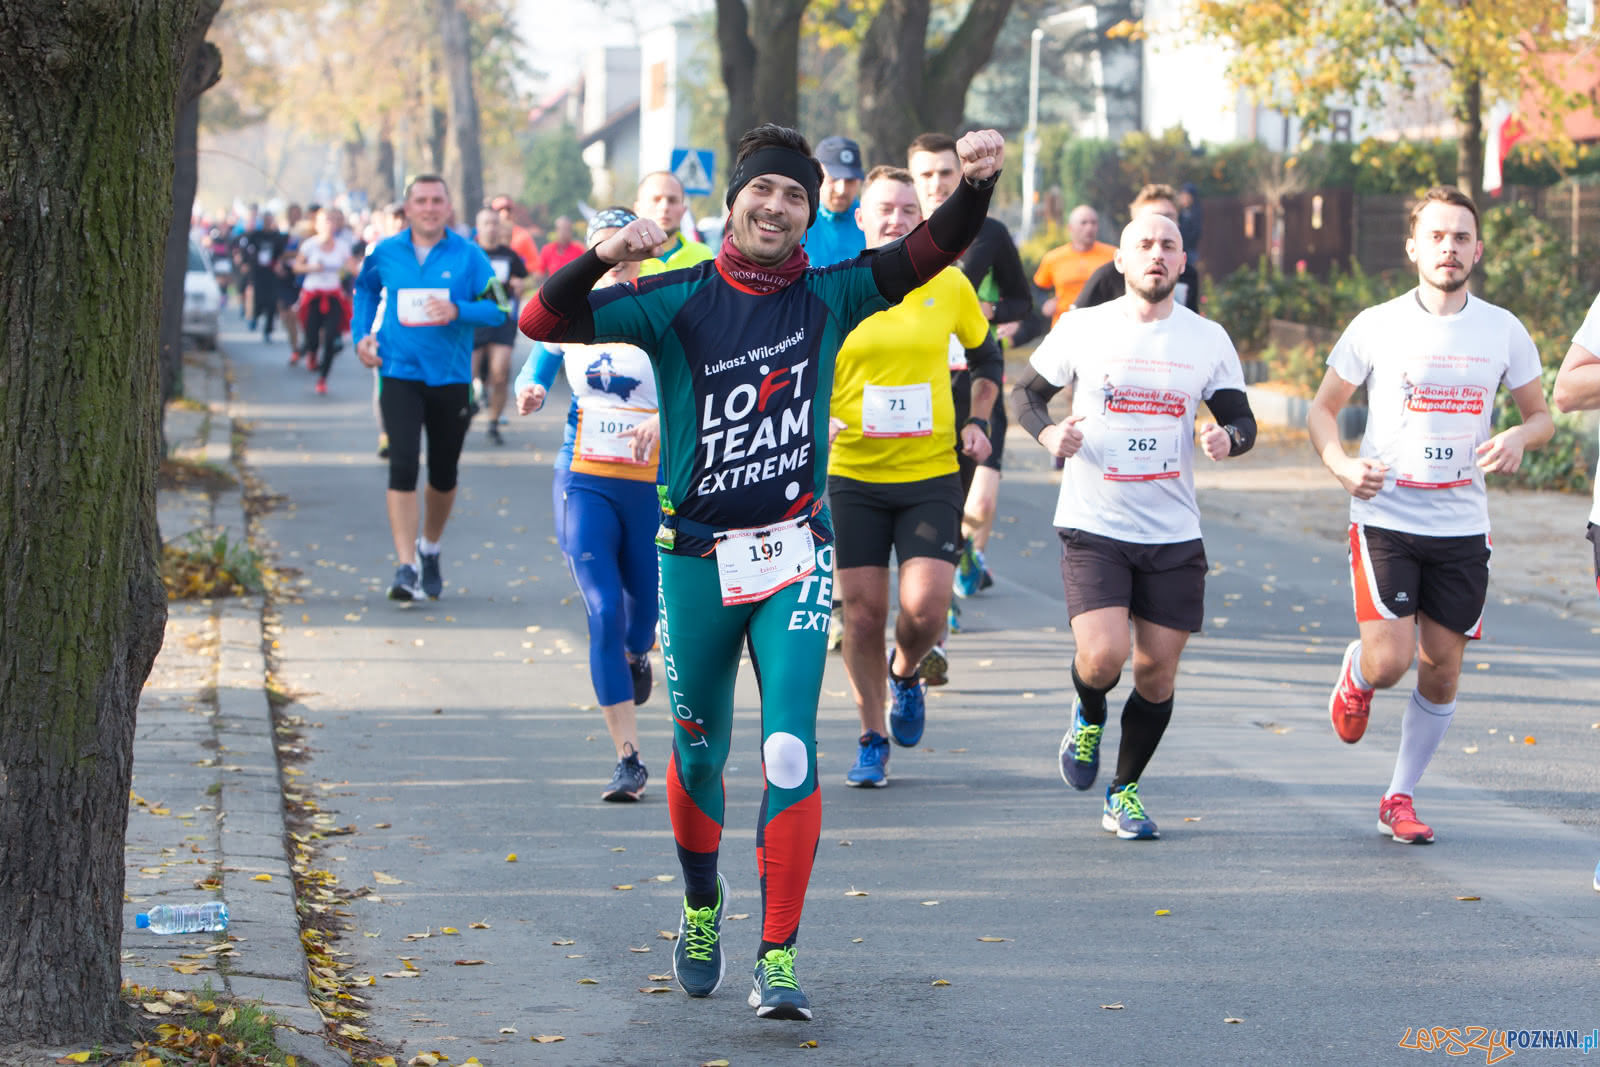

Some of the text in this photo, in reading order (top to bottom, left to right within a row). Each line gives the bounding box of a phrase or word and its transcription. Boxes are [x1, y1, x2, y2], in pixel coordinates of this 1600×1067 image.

[704, 327, 805, 376] Łukasz Wilczyński
[702, 358, 809, 431] LOFT
[888, 399, 906, 411] 71
[1163, 391, 1186, 404] Bieg
[1461, 388, 1483, 400] Bieg
[701, 399, 811, 469] TEAM
[1127, 438, 1157, 451] 262
[1424, 447, 1454, 460] 519
[697, 442, 811, 497] EXTREME
[749, 541, 783, 562] 199
[797, 575, 833, 609] TE
[788, 610, 832, 635] EXT
[665, 653, 679, 681] TO
